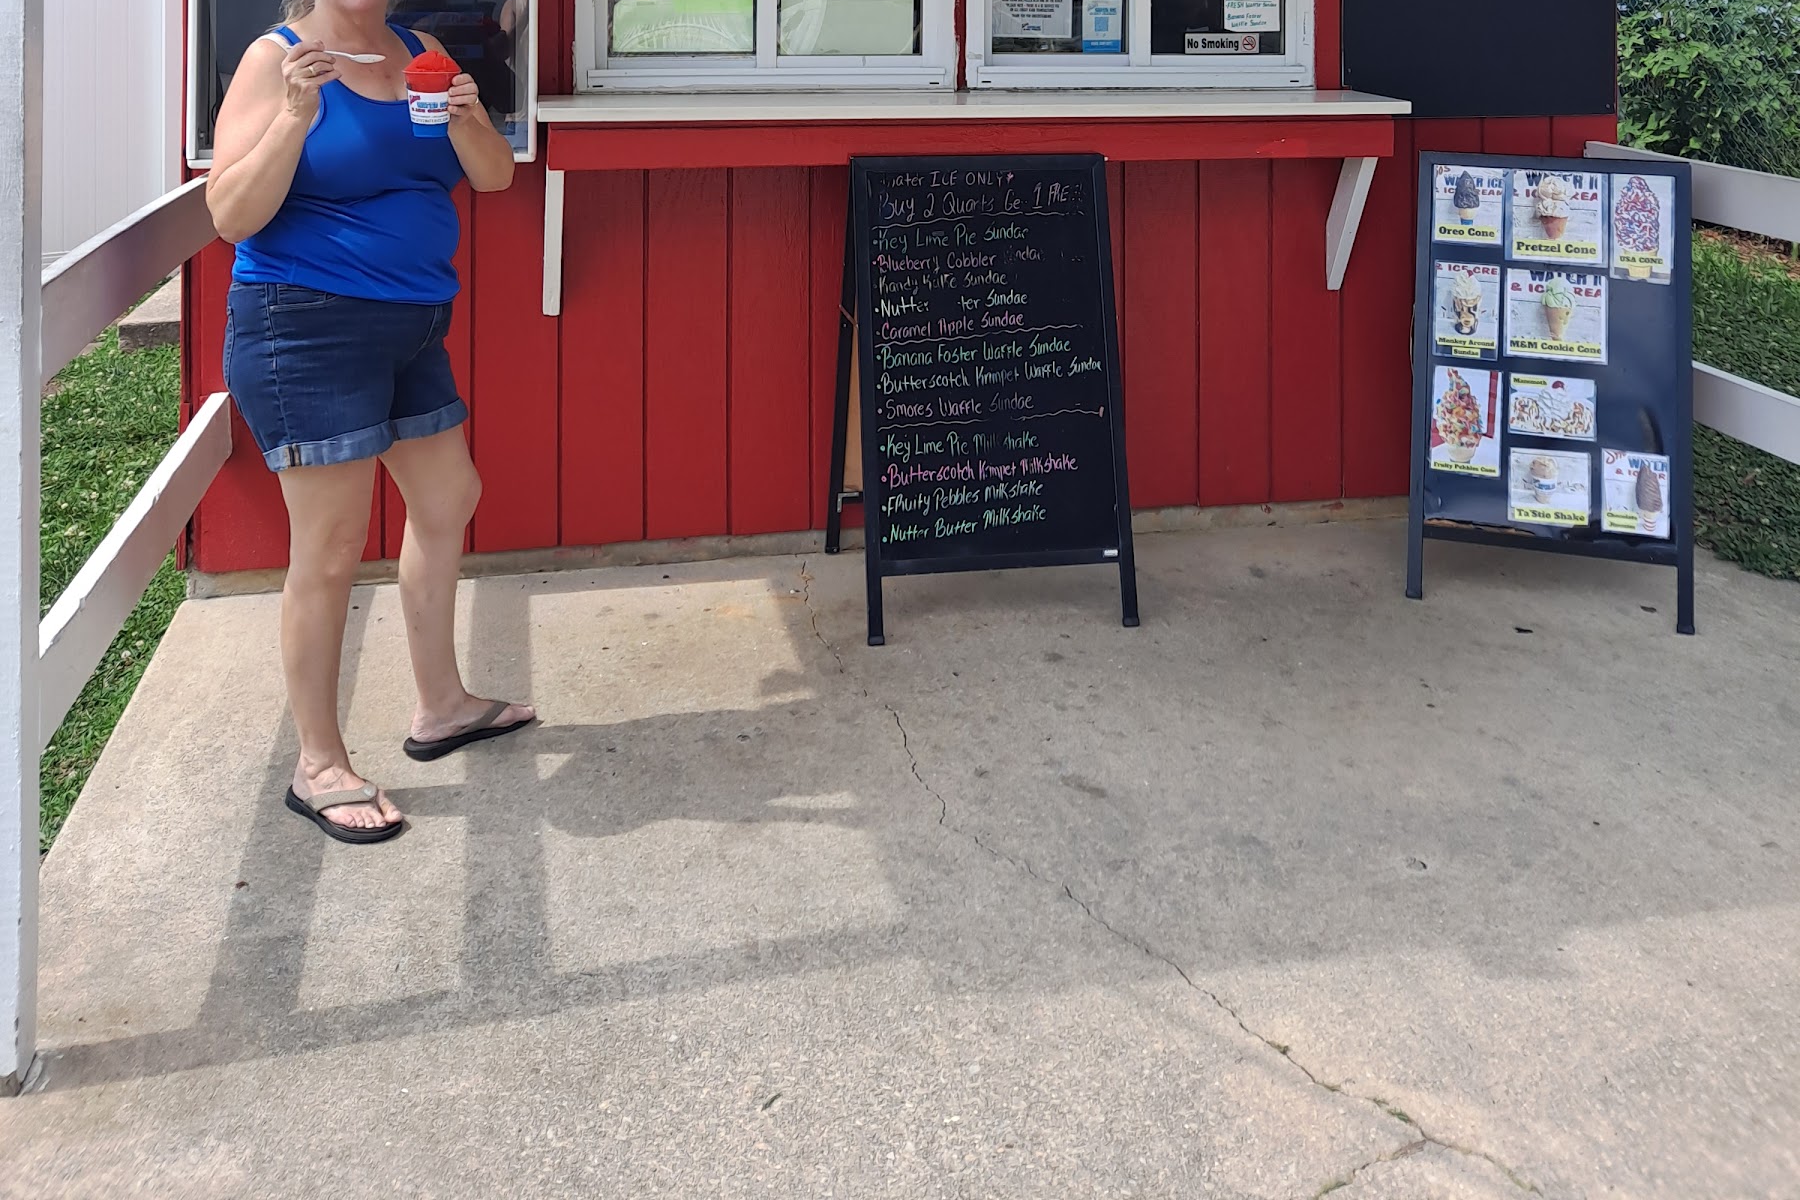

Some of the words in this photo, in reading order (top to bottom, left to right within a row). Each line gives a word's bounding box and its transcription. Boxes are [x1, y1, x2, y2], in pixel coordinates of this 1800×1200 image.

[1187, 39, 1199, 48] No
[1201, 38, 1239, 51] Smoking
[929, 170, 957, 187] ICE
[923, 192, 935, 218] 2
[943, 191, 994, 215] Quarts
[880, 228, 907, 253] Key
[917, 228, 949, 247] Lime
[954, 223, 976, 246] Pie
[1439, 226, 1464, 236] Oreo
[1468, 228, 1495, 237] Cone
[1516, 242, 1561, 253] Pretzel
[1565, 244, 1596, 255] Cone
[877, 254, 940, 274] Blueberry
[947, 251, 997, 269] Cobbler
[963, 270, 1008, 288] Sundae
[1511, 282, 1522, 291] &
[1529, 284, 1547, 293] IC
[985, 289, 1028, 307] Sundae
[882, 321, 931, 340] Caramel
[938, 315, 974, 336] Apple
[981, 311, 1024, 328] Sundae
[881, 345, 933, 370] Banana
[938, 343, 978, 363] Foster
[983, 341, 1023, 360] Waffle
[1029, 334, 1071, 357] Sundae
[1438, 337, 1467, 346] Monkey
[1510, 340, 1538, 349] M&M
[1541, 341, 1574, 352] Cookie
[1577, 345, 1601, 354] Cone
[881, 367, 971, 395] Butterscotch
[1025, 361, 1063, 380] Waffle
[886, 399, 933, 420] Smores
[939, 397, 982, 417] Waffle
[989, 392, 1034, 412] Sundae
[887, 433, 910, 463] Key
[915, 433, 944, 455] Lime
[947, 431, 969, 457] Pie
[887, 459, 975, 490] Butterscotch
[1020, 452, 1078, 477] Milkshake
[933, 485, 980, 511] Pebbles
[890, 524, 929, 544] Nutter
[935, 517, 978, 538] Butter
[983, 504, 1046, 530] Milkshake
[1554, 512, 1585, 521] Shake
